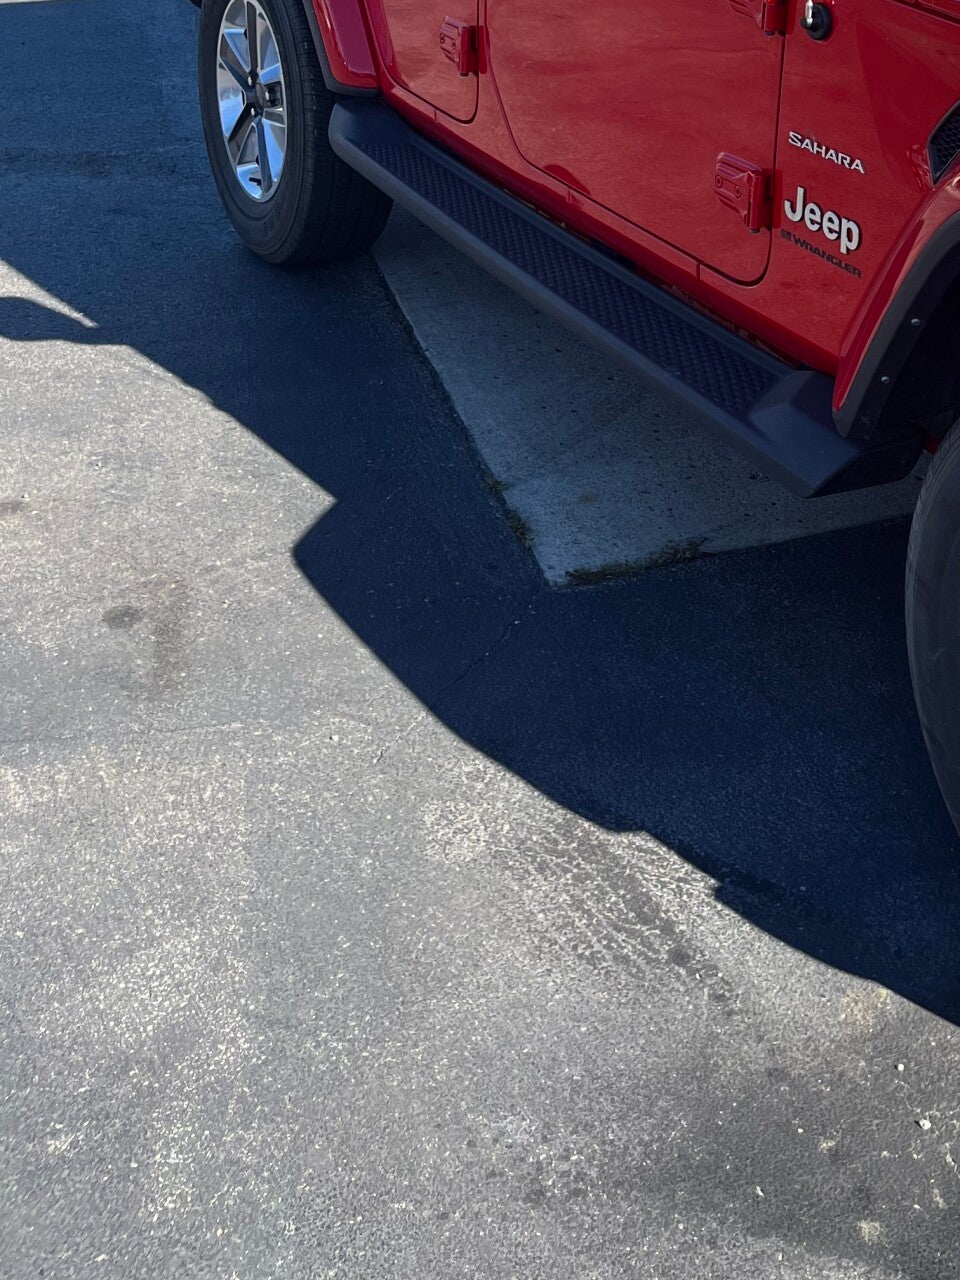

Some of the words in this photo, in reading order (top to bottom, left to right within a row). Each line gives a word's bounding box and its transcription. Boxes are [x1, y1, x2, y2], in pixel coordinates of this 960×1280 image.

[788, 130, 865, 174] SAHARA
[784, 186, 861, 255] Jeep
[793, 235, 862, 278] WRANGLER
